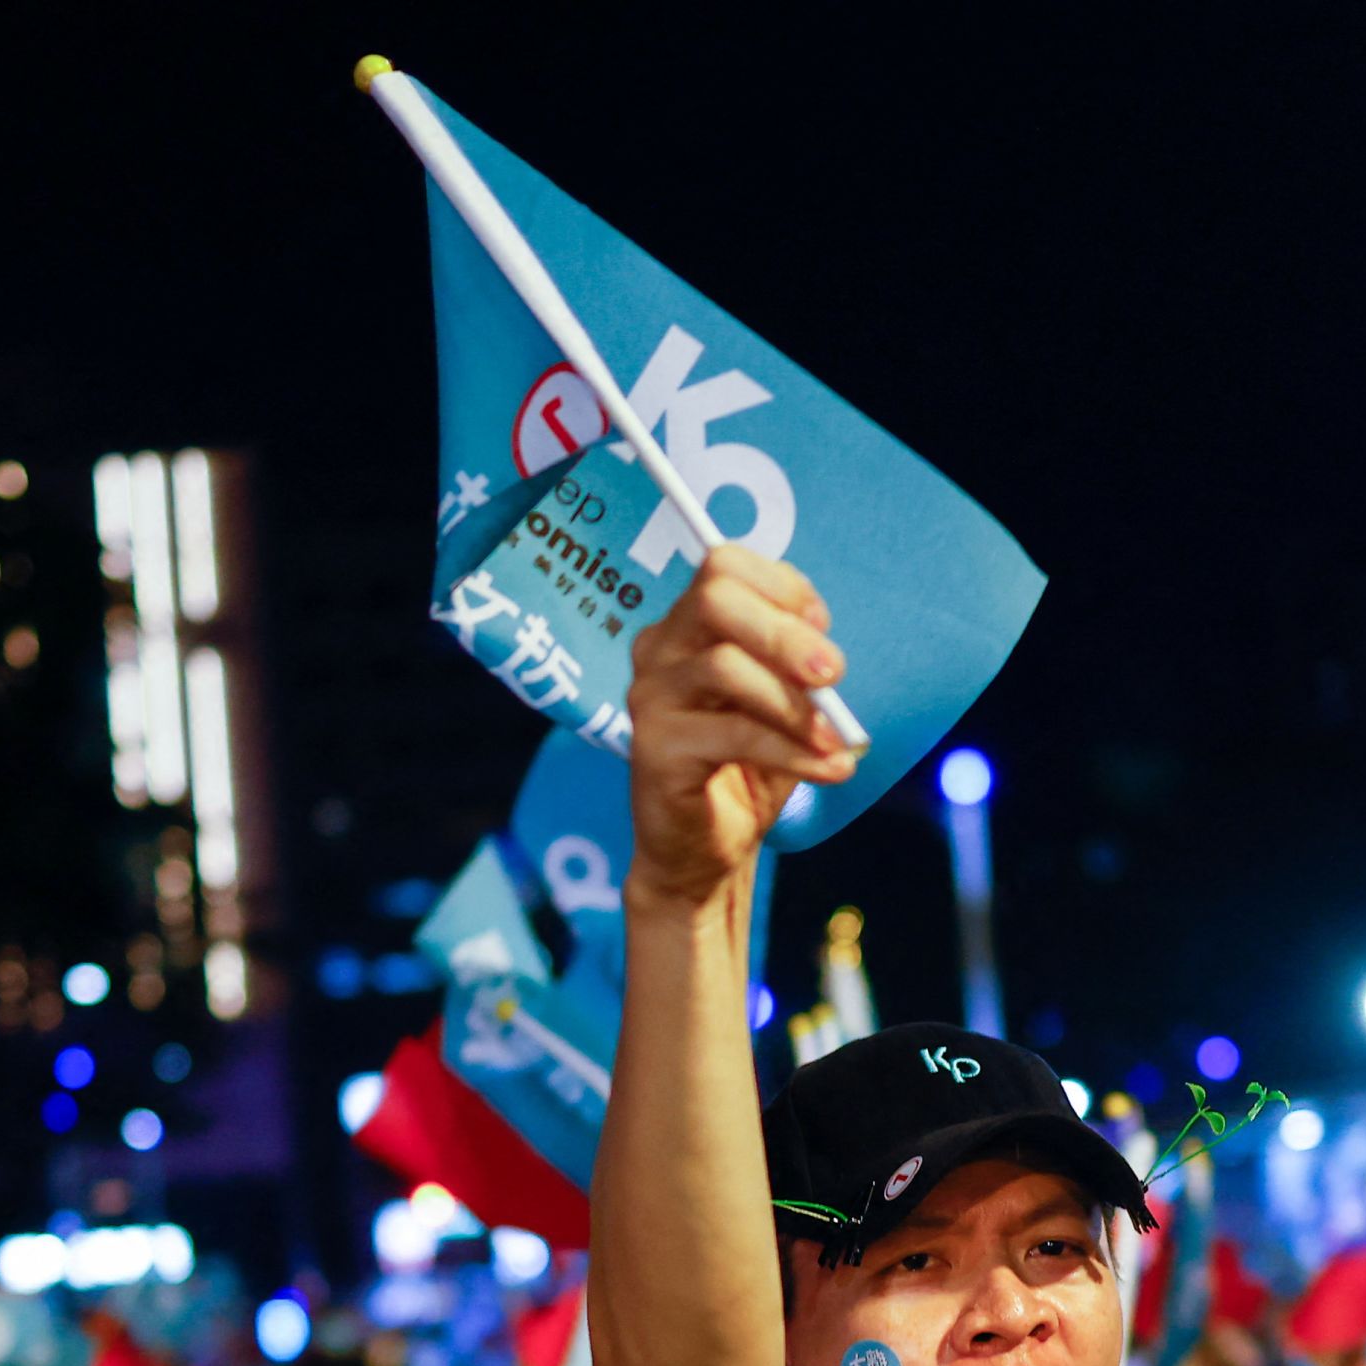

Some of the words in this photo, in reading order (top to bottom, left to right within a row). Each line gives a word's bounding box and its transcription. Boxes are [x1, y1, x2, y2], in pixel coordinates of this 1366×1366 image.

[605, 323, 796, 577] Kp
[554, 477, 606, 524] ep
[527, 510, 644, 610] omise
